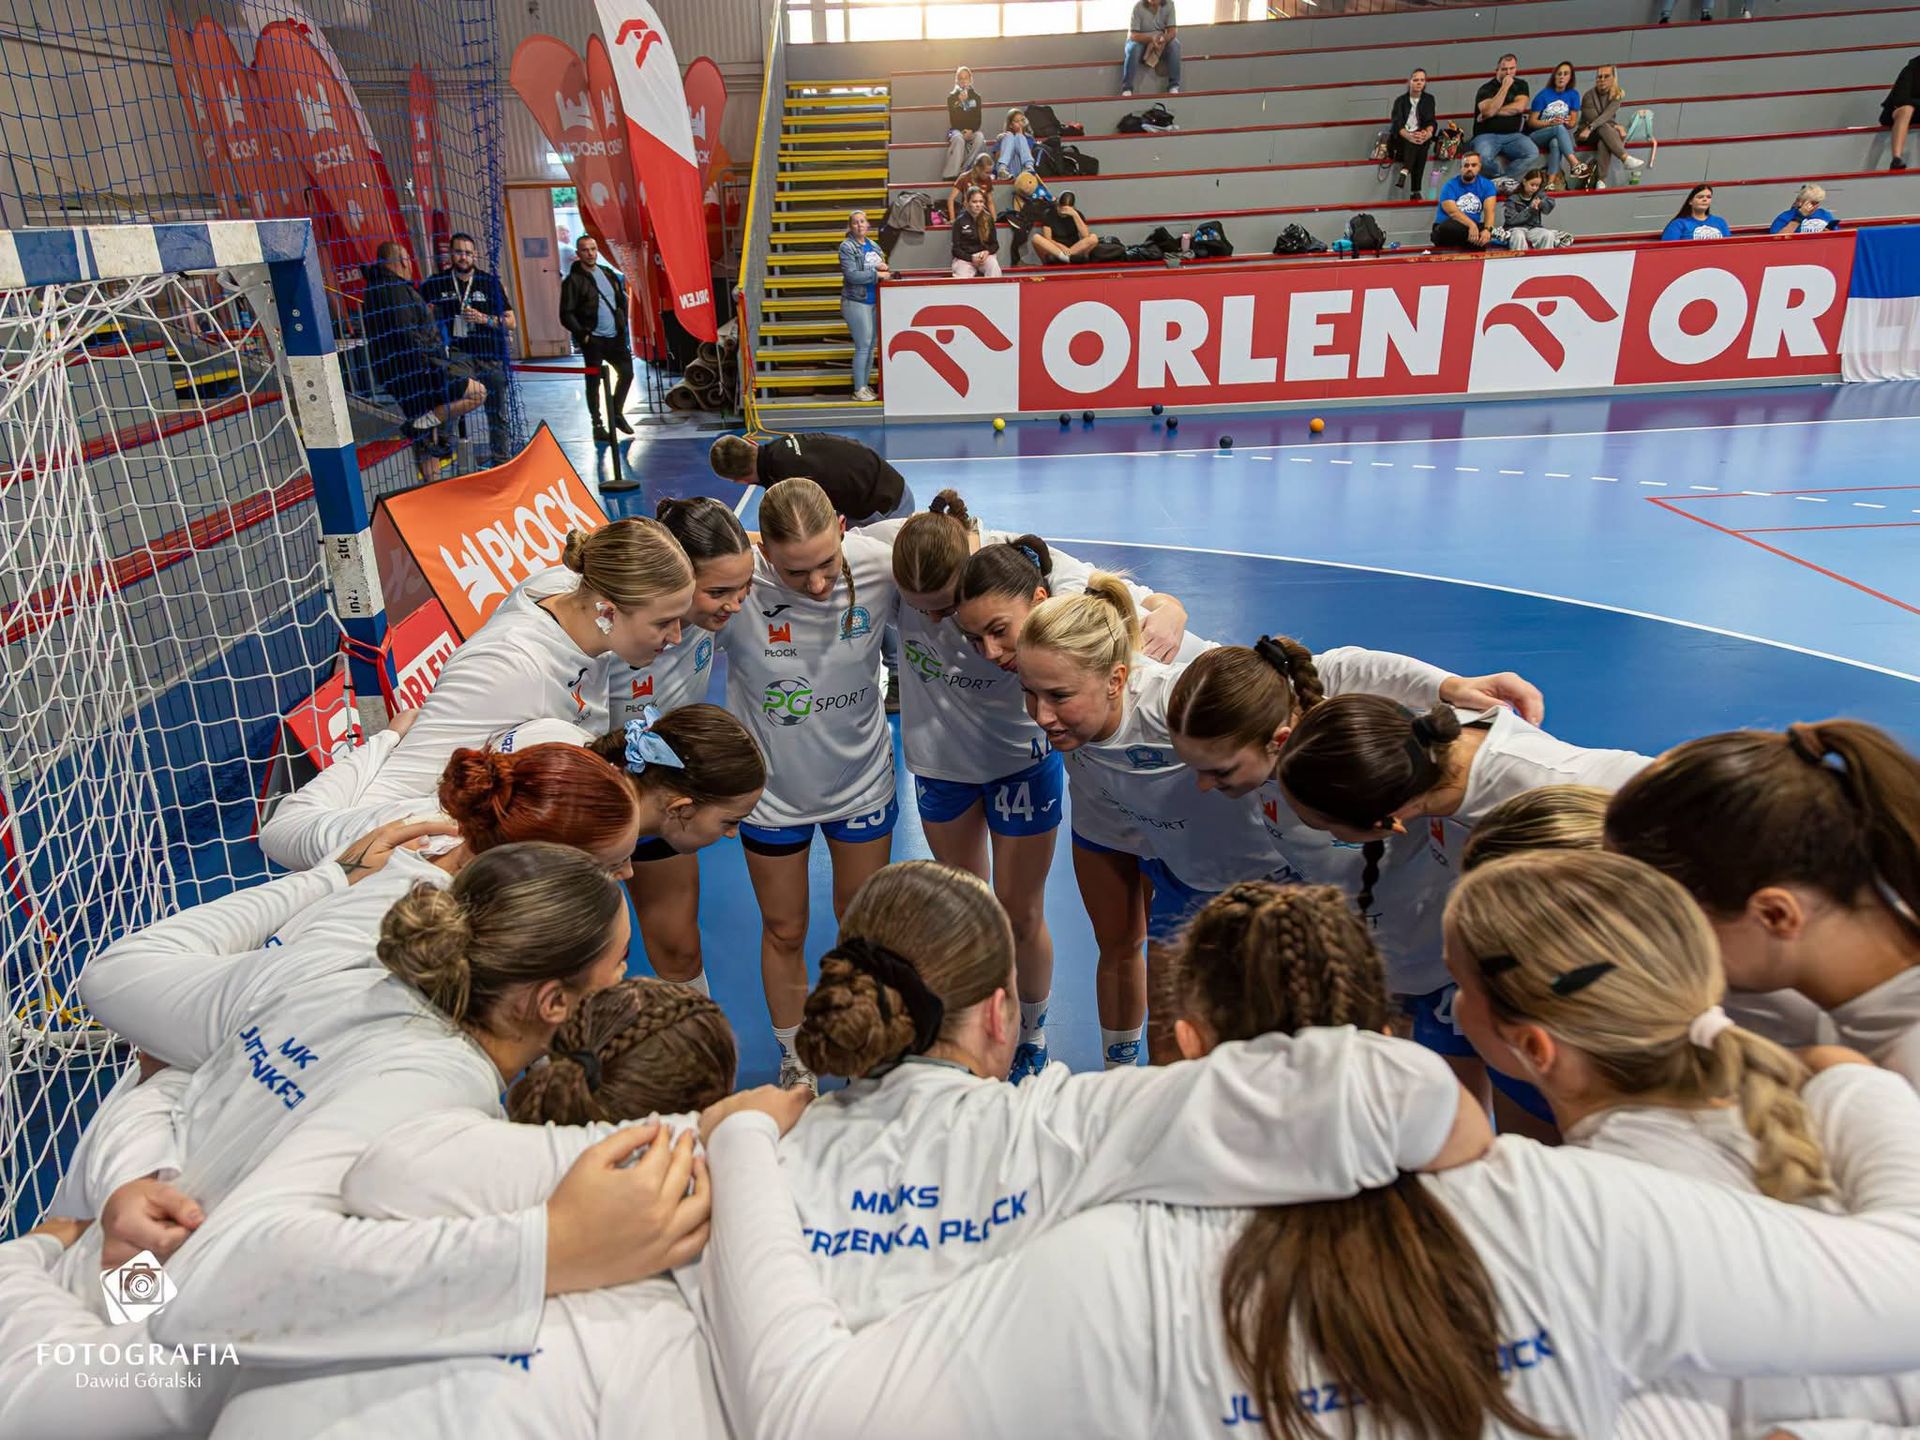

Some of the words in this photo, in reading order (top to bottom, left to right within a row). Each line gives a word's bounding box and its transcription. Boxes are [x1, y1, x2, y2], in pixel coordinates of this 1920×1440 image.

[1042, 284, 1450, 394] ORLEN
[1649, 264, 1848, 365] OR
[476, 478, 598, 594] PŁOCK
[764, 648, 798, 658] PŁOCK
[815, 687, 869, 713] SPORT
[994, 781, 1035, 822] 44
